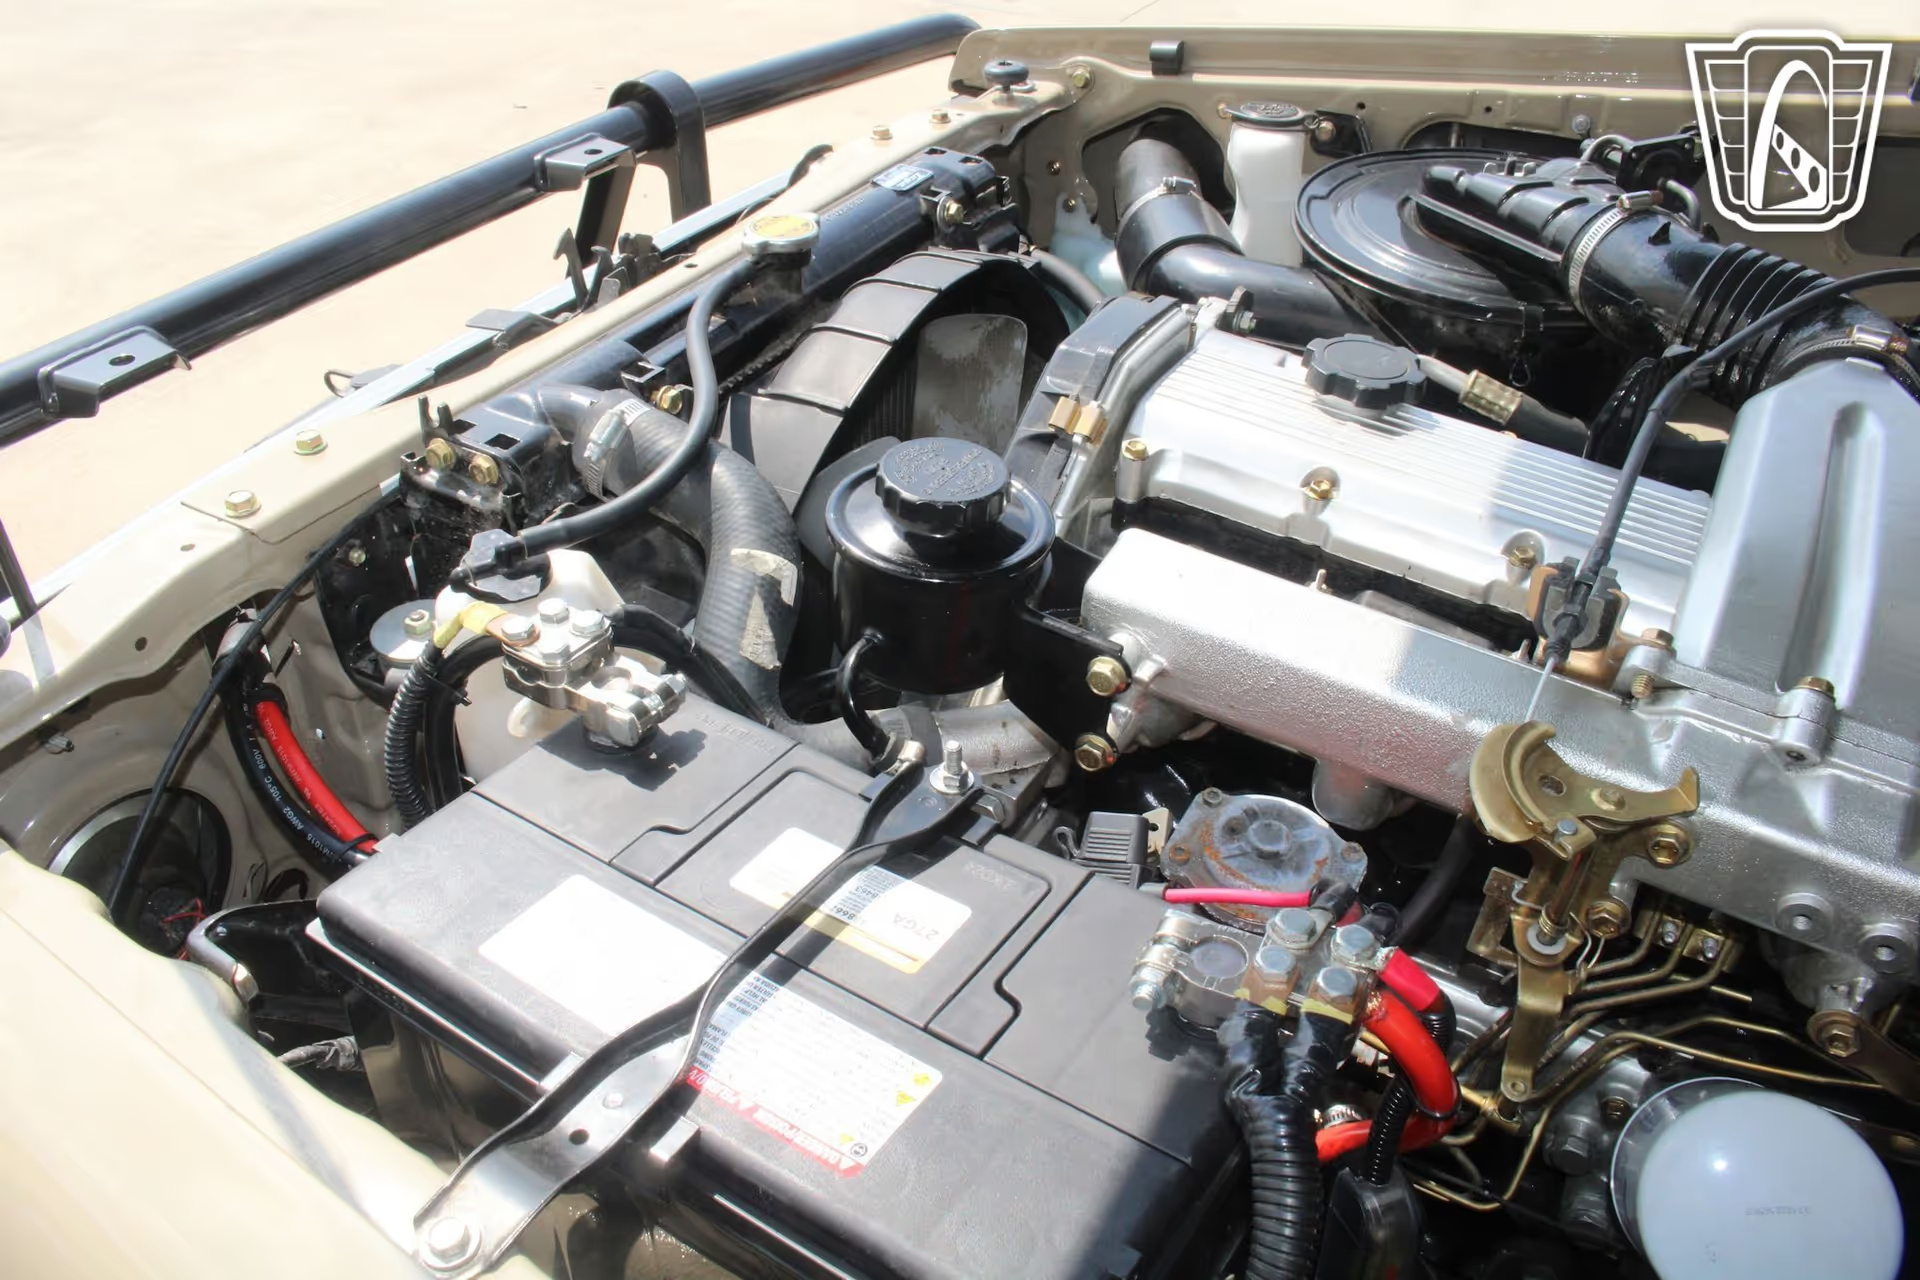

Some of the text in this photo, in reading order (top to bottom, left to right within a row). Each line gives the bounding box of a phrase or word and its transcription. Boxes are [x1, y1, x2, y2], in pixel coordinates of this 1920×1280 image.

[252, 748, 267, 770] 600V
[263, 775, 282, 802] 105°C
[282, 806, 304, 831] AWG2
